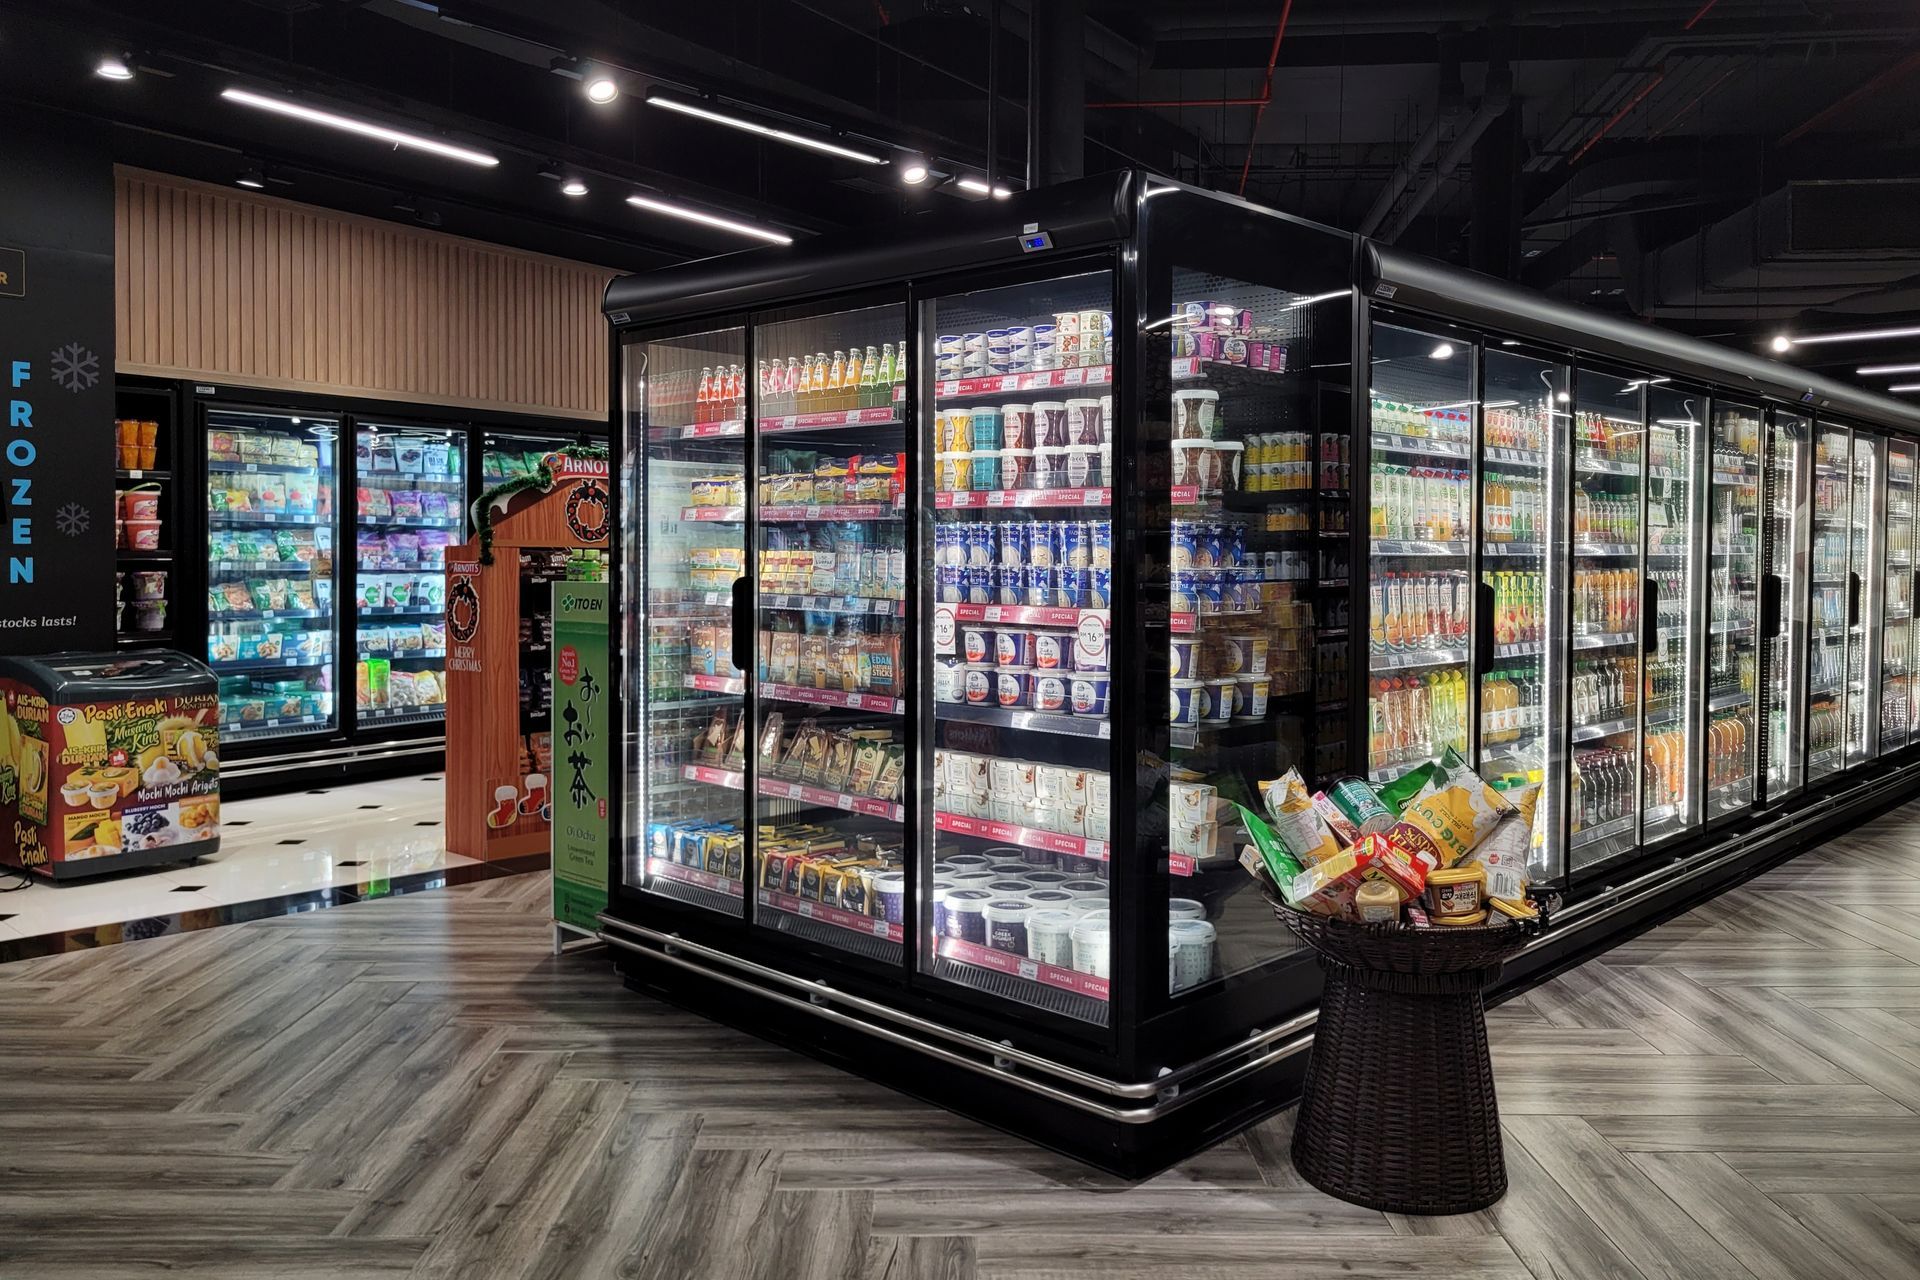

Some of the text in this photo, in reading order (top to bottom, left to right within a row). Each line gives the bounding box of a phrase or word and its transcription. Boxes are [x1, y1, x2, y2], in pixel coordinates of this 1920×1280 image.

[6, 361, 37, 585] FROZEN
[574, 598, 603, 611] ITO EN
[41, 616, 77, 628] lasts!
[1051, 612, 1074, 620] SPECIAL
[939, 624, 948, 634] 16
[1087, 632, 1097, 643] 16
[454, 647, 475, 659] MERRY
[449, 659, 482, 672] CHRISTMAS
[872, 656, 892, 665] EDAM
[872, 669, 893, 677] STICKS
[174, 694, 219, 710] DURIAN
[870, 699, 889, 708] SPECIAL
[16, 706, 49, 723] DURIAN
[84, 697, 168, 724] Pasti Enak!
[112, 718, 156, 744] Musang
[130, 730, 160, 753] King
[61, 753, 108, 767] DURIAN
[137, 778, 219, 802] Mochi Mochi Arigato
[150, 803, 166, 811] MOCHI
[867, 803, 885, 813] SPECIAL
[1411, 802, 1444, 829] CUT
[14, 820, 37, 844] Pasti
[951, 820, 972, 830] SPECIAL
[992, 827, 1013, 838] SPECIAL
[1055, 838, 1078, 849] SPECIAL
[1440, 827, 1468, 856] BIG
[20, 842, 49, 866] Enak!
[857, 920, 873, 930] SPECIA
[984, 954, 1006, 966] SPECIAL
[1050, 971, 1073, 984] SPECIAL
